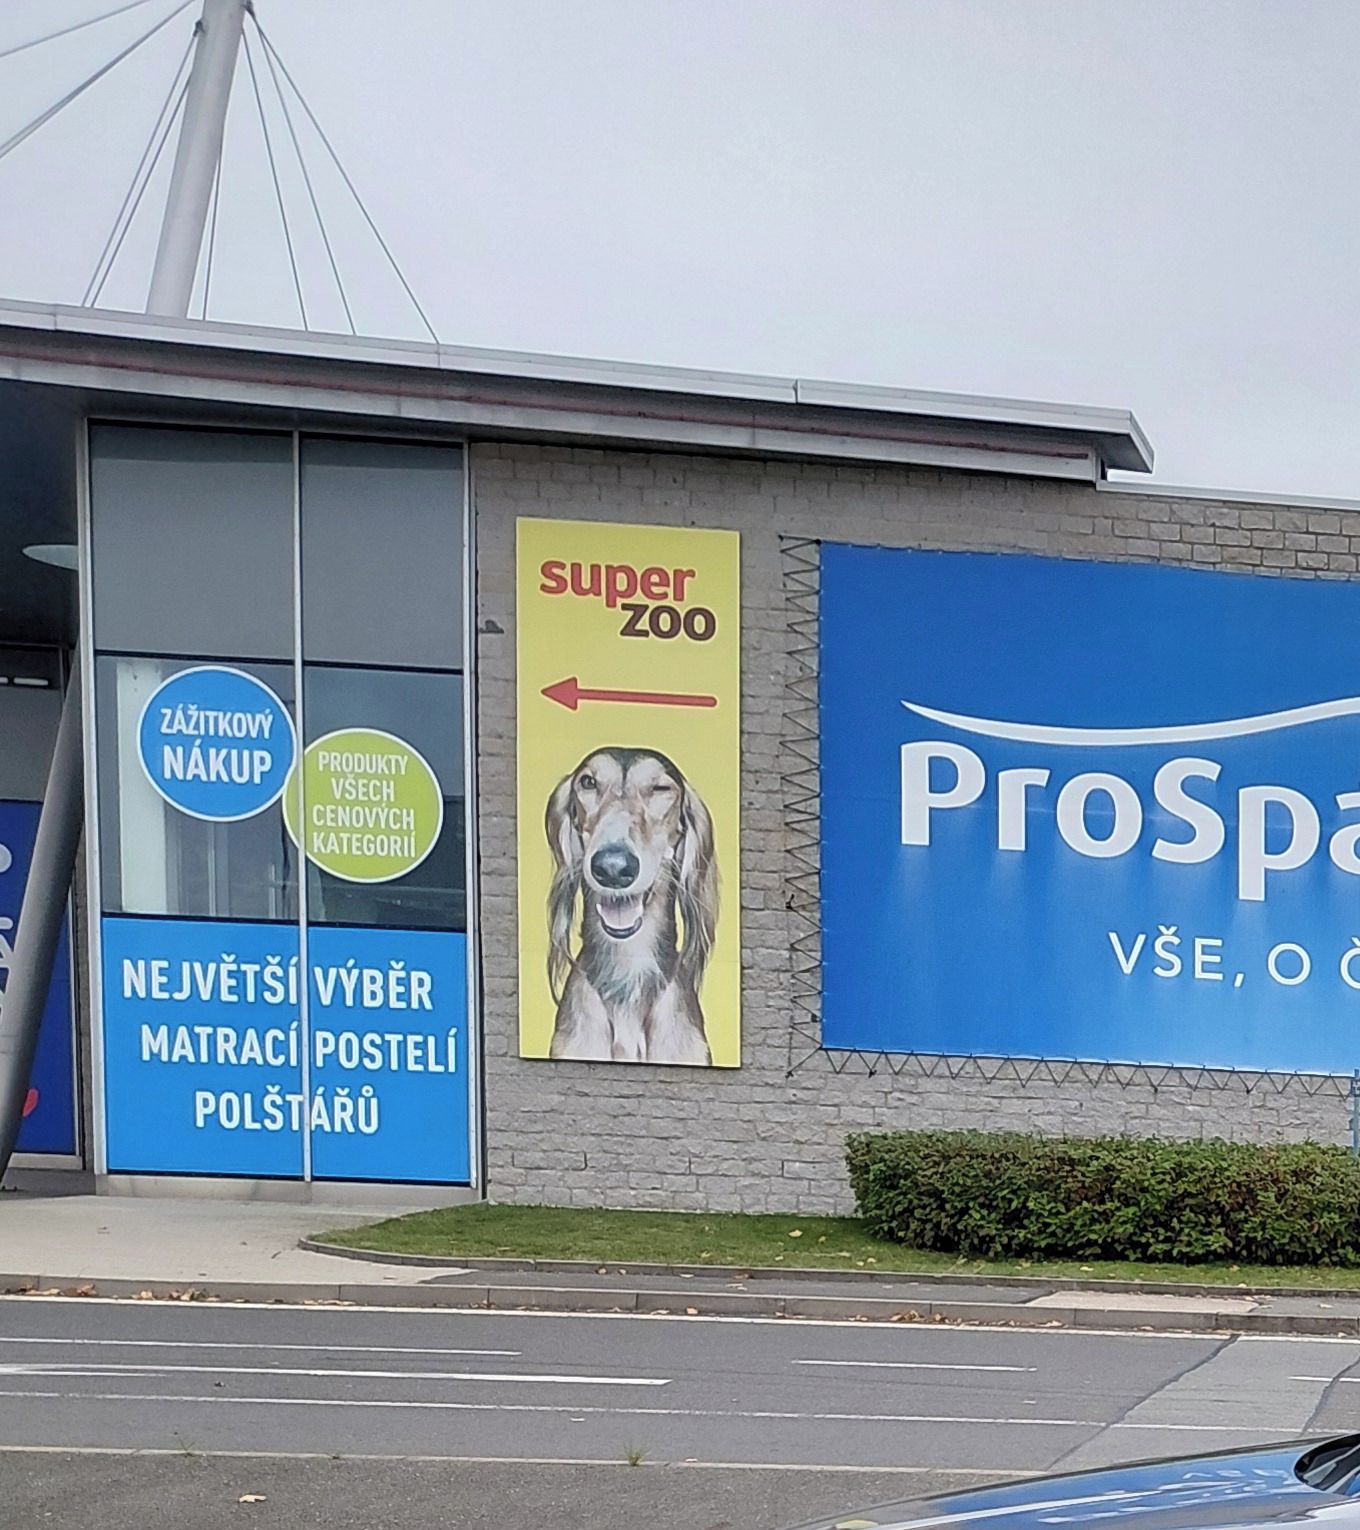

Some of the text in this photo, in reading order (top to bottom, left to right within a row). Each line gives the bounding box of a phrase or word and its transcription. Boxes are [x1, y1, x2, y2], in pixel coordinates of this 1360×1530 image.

[540, 558, 697, 612] super
[160, 703, 273, 740] ZÁŽITKOVÝ
[163, 738, 273, 785] NÁKUP
[317, 749, 409, 776] PRODUKTY
[330, 771, 396, 804] VŠECH
[312, 799, 416, 832] CENOVÝCH
[312, 827, 417, 859] KATEGORIÍ
[1108, 925, 1246, 990] VŠE,
[1266, 942, 1312, 987] O
[122, 953, 433, 1011] NEJVĚTŠÍ VÝBĚR
[140, 1020, 458, 1074] MATRACÍ POSTELÍ
[195, 1083, 380, 1135] POLŠTÁŘŮ
